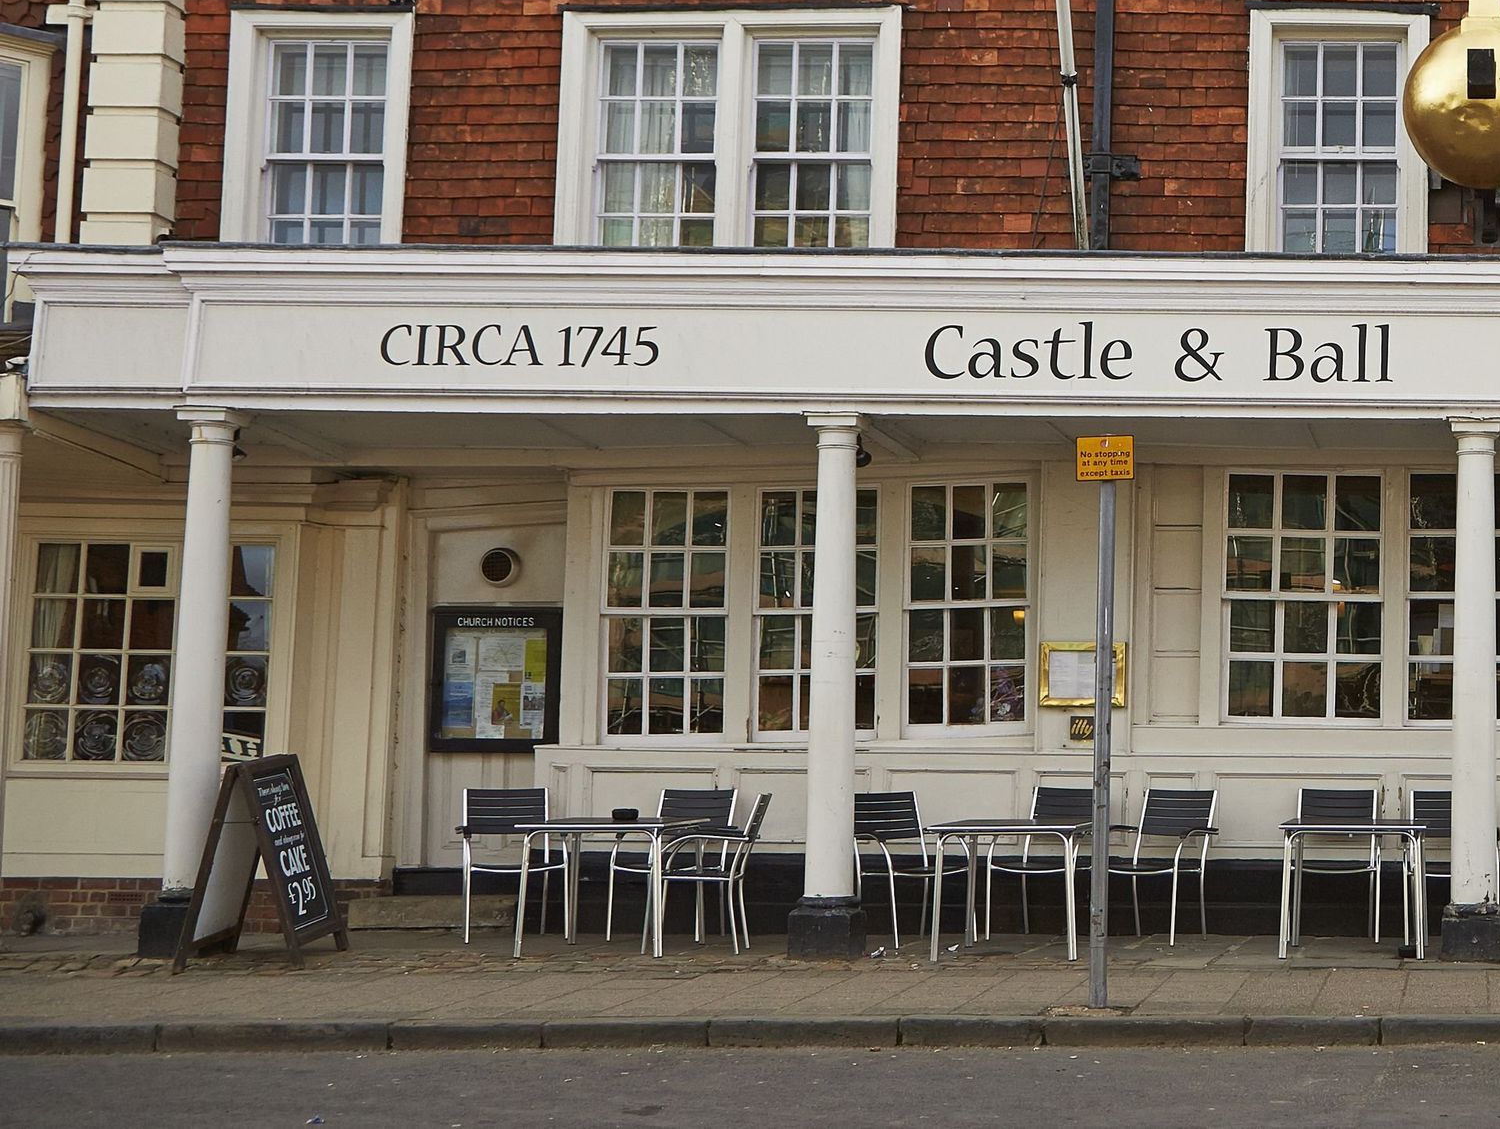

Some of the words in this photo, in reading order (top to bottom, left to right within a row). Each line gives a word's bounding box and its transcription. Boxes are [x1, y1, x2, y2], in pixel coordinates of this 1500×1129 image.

[380, 324, 543, 367] CIRCA
[558, 325, 660, 368] 1745
[924, 321, 1133, 380] Castle
[1174, 327, 1225, 383] &
[1263, 323, 1394, 384] Ball
[457, 617, 493, 627] CHURCH
[494, 617, 535, 627] NOTICES
[1071, 719, 1094, 739] illy
[265, 802, 302, 833] COFFEE
[279, 845, 311, 878] CAKE
[288, 876, 317, 916] £2.95
